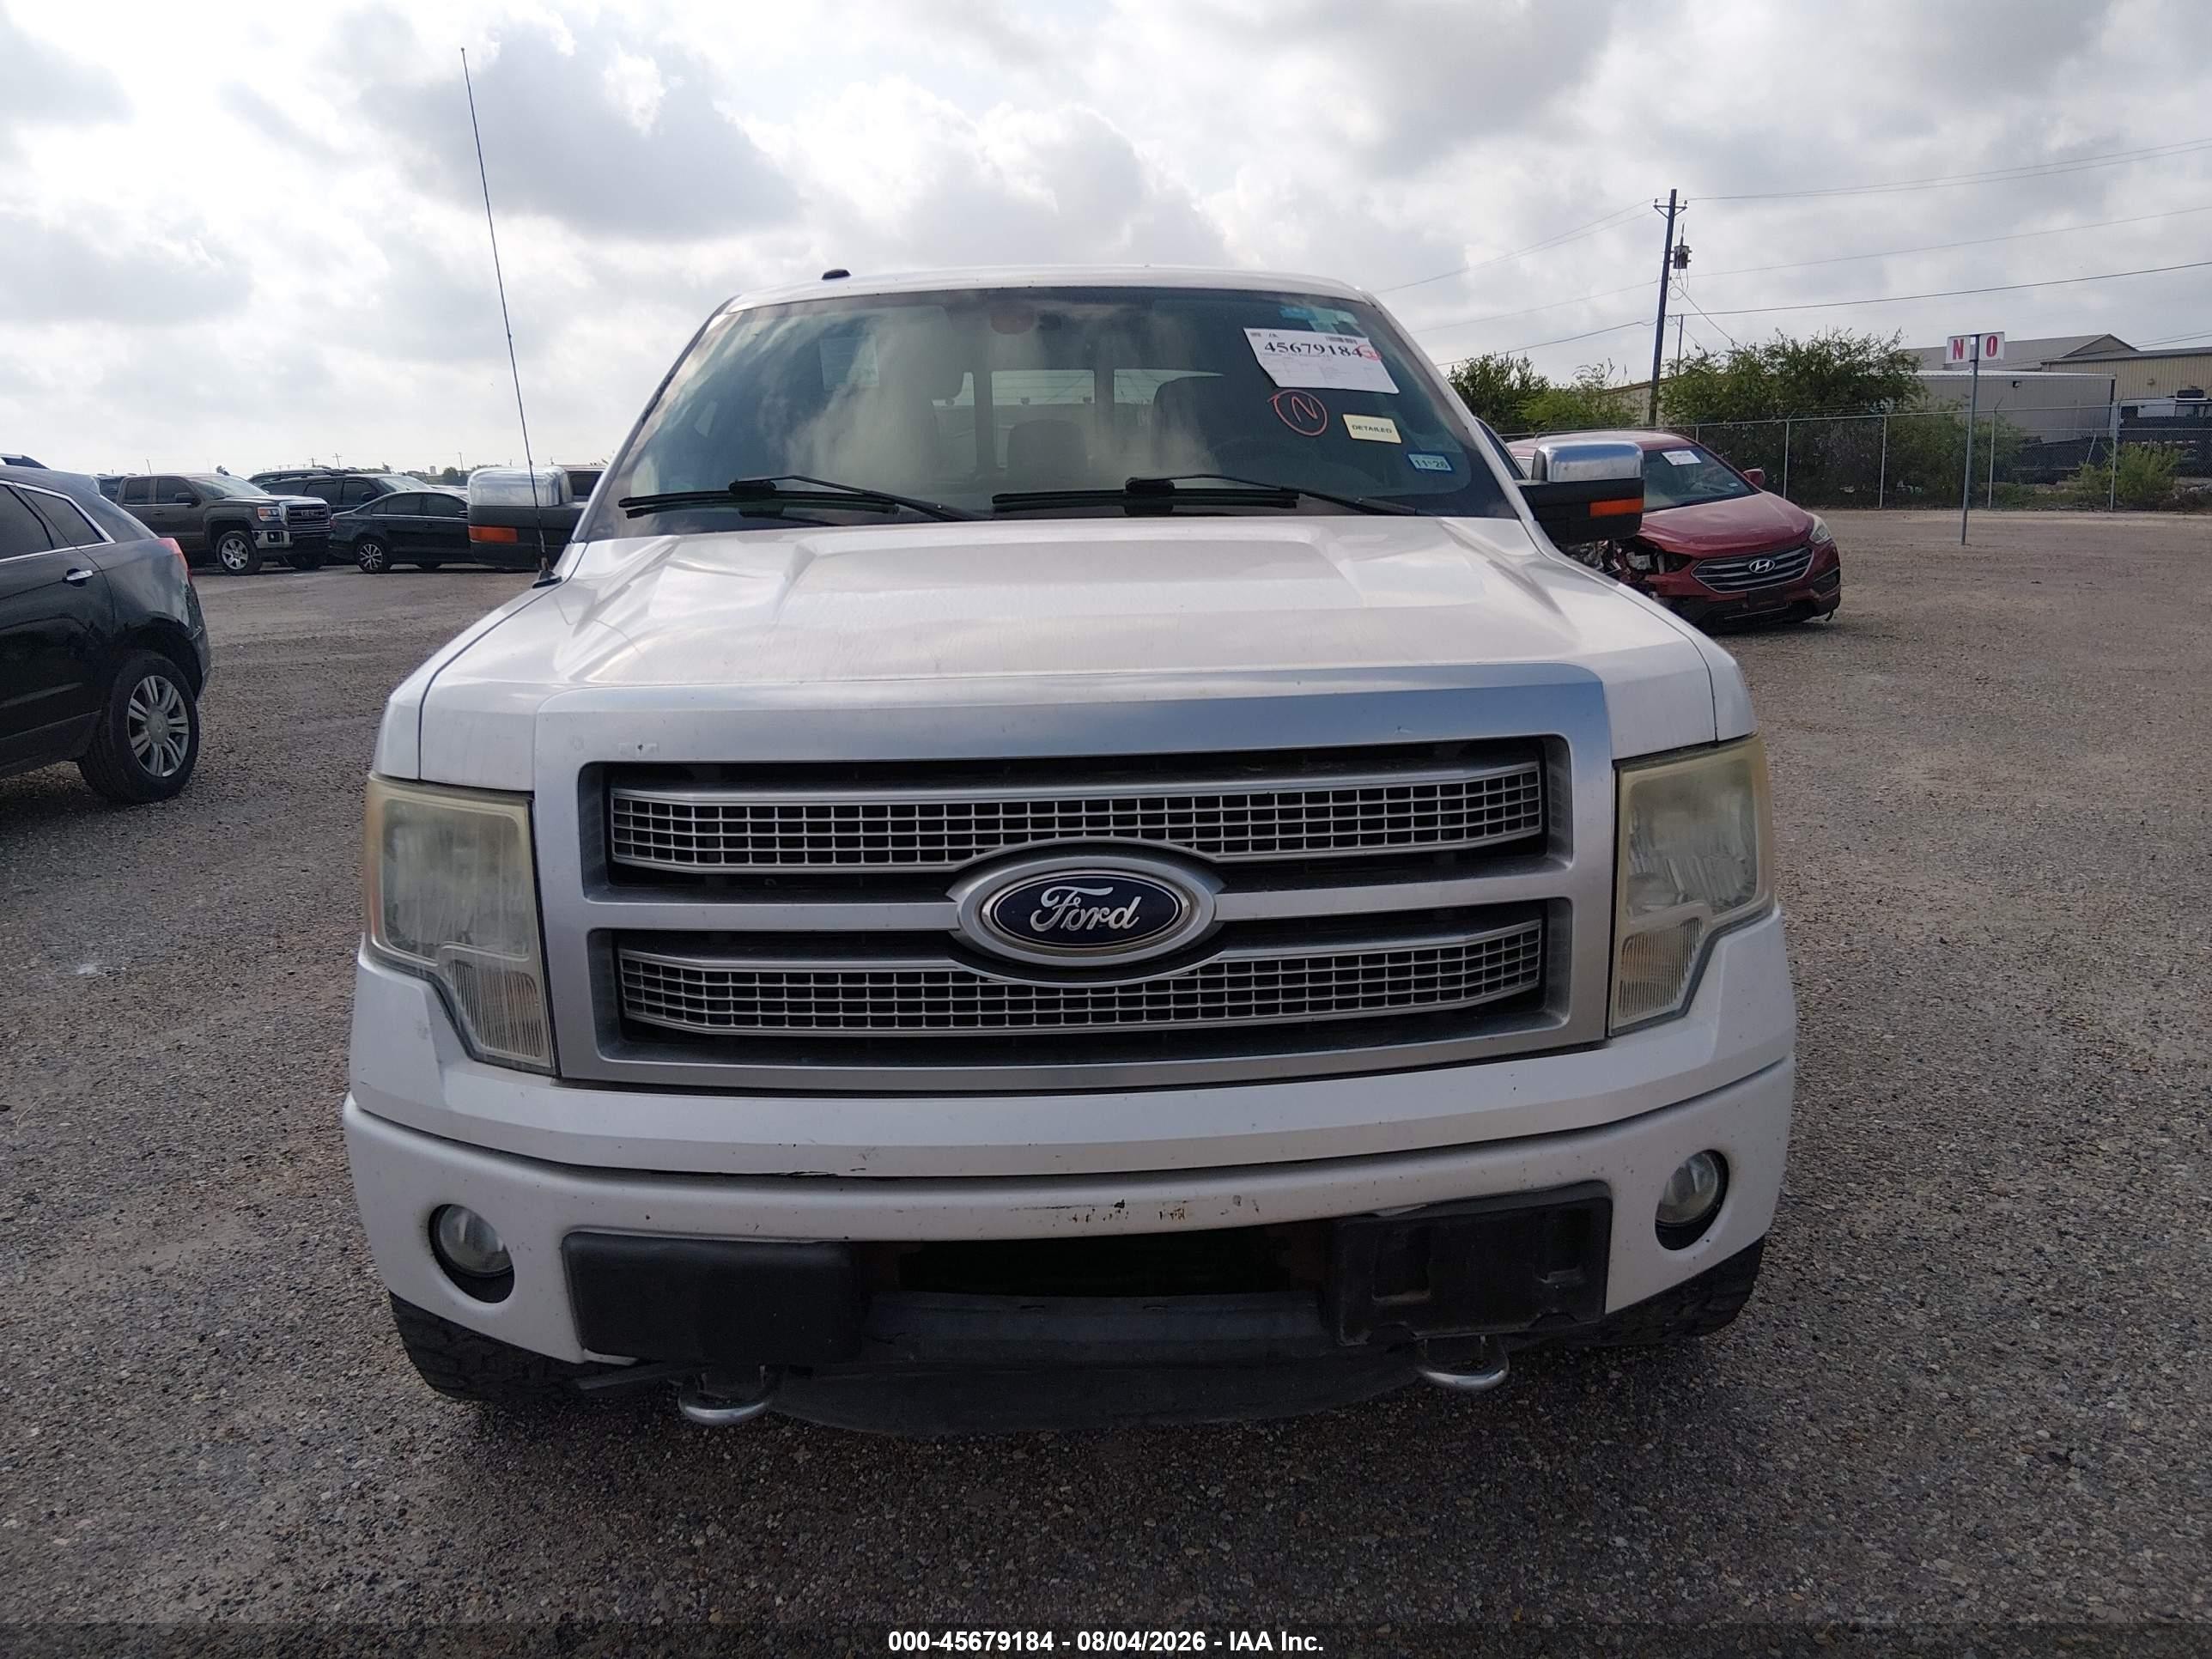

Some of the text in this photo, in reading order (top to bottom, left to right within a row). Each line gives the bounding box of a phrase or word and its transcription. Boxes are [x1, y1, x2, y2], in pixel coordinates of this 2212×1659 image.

[1264, 342, 1362, 358] 45679184
[1352, 424, 1393, 434] DETAILED
[1030, 885, 1142, 933] Ford
